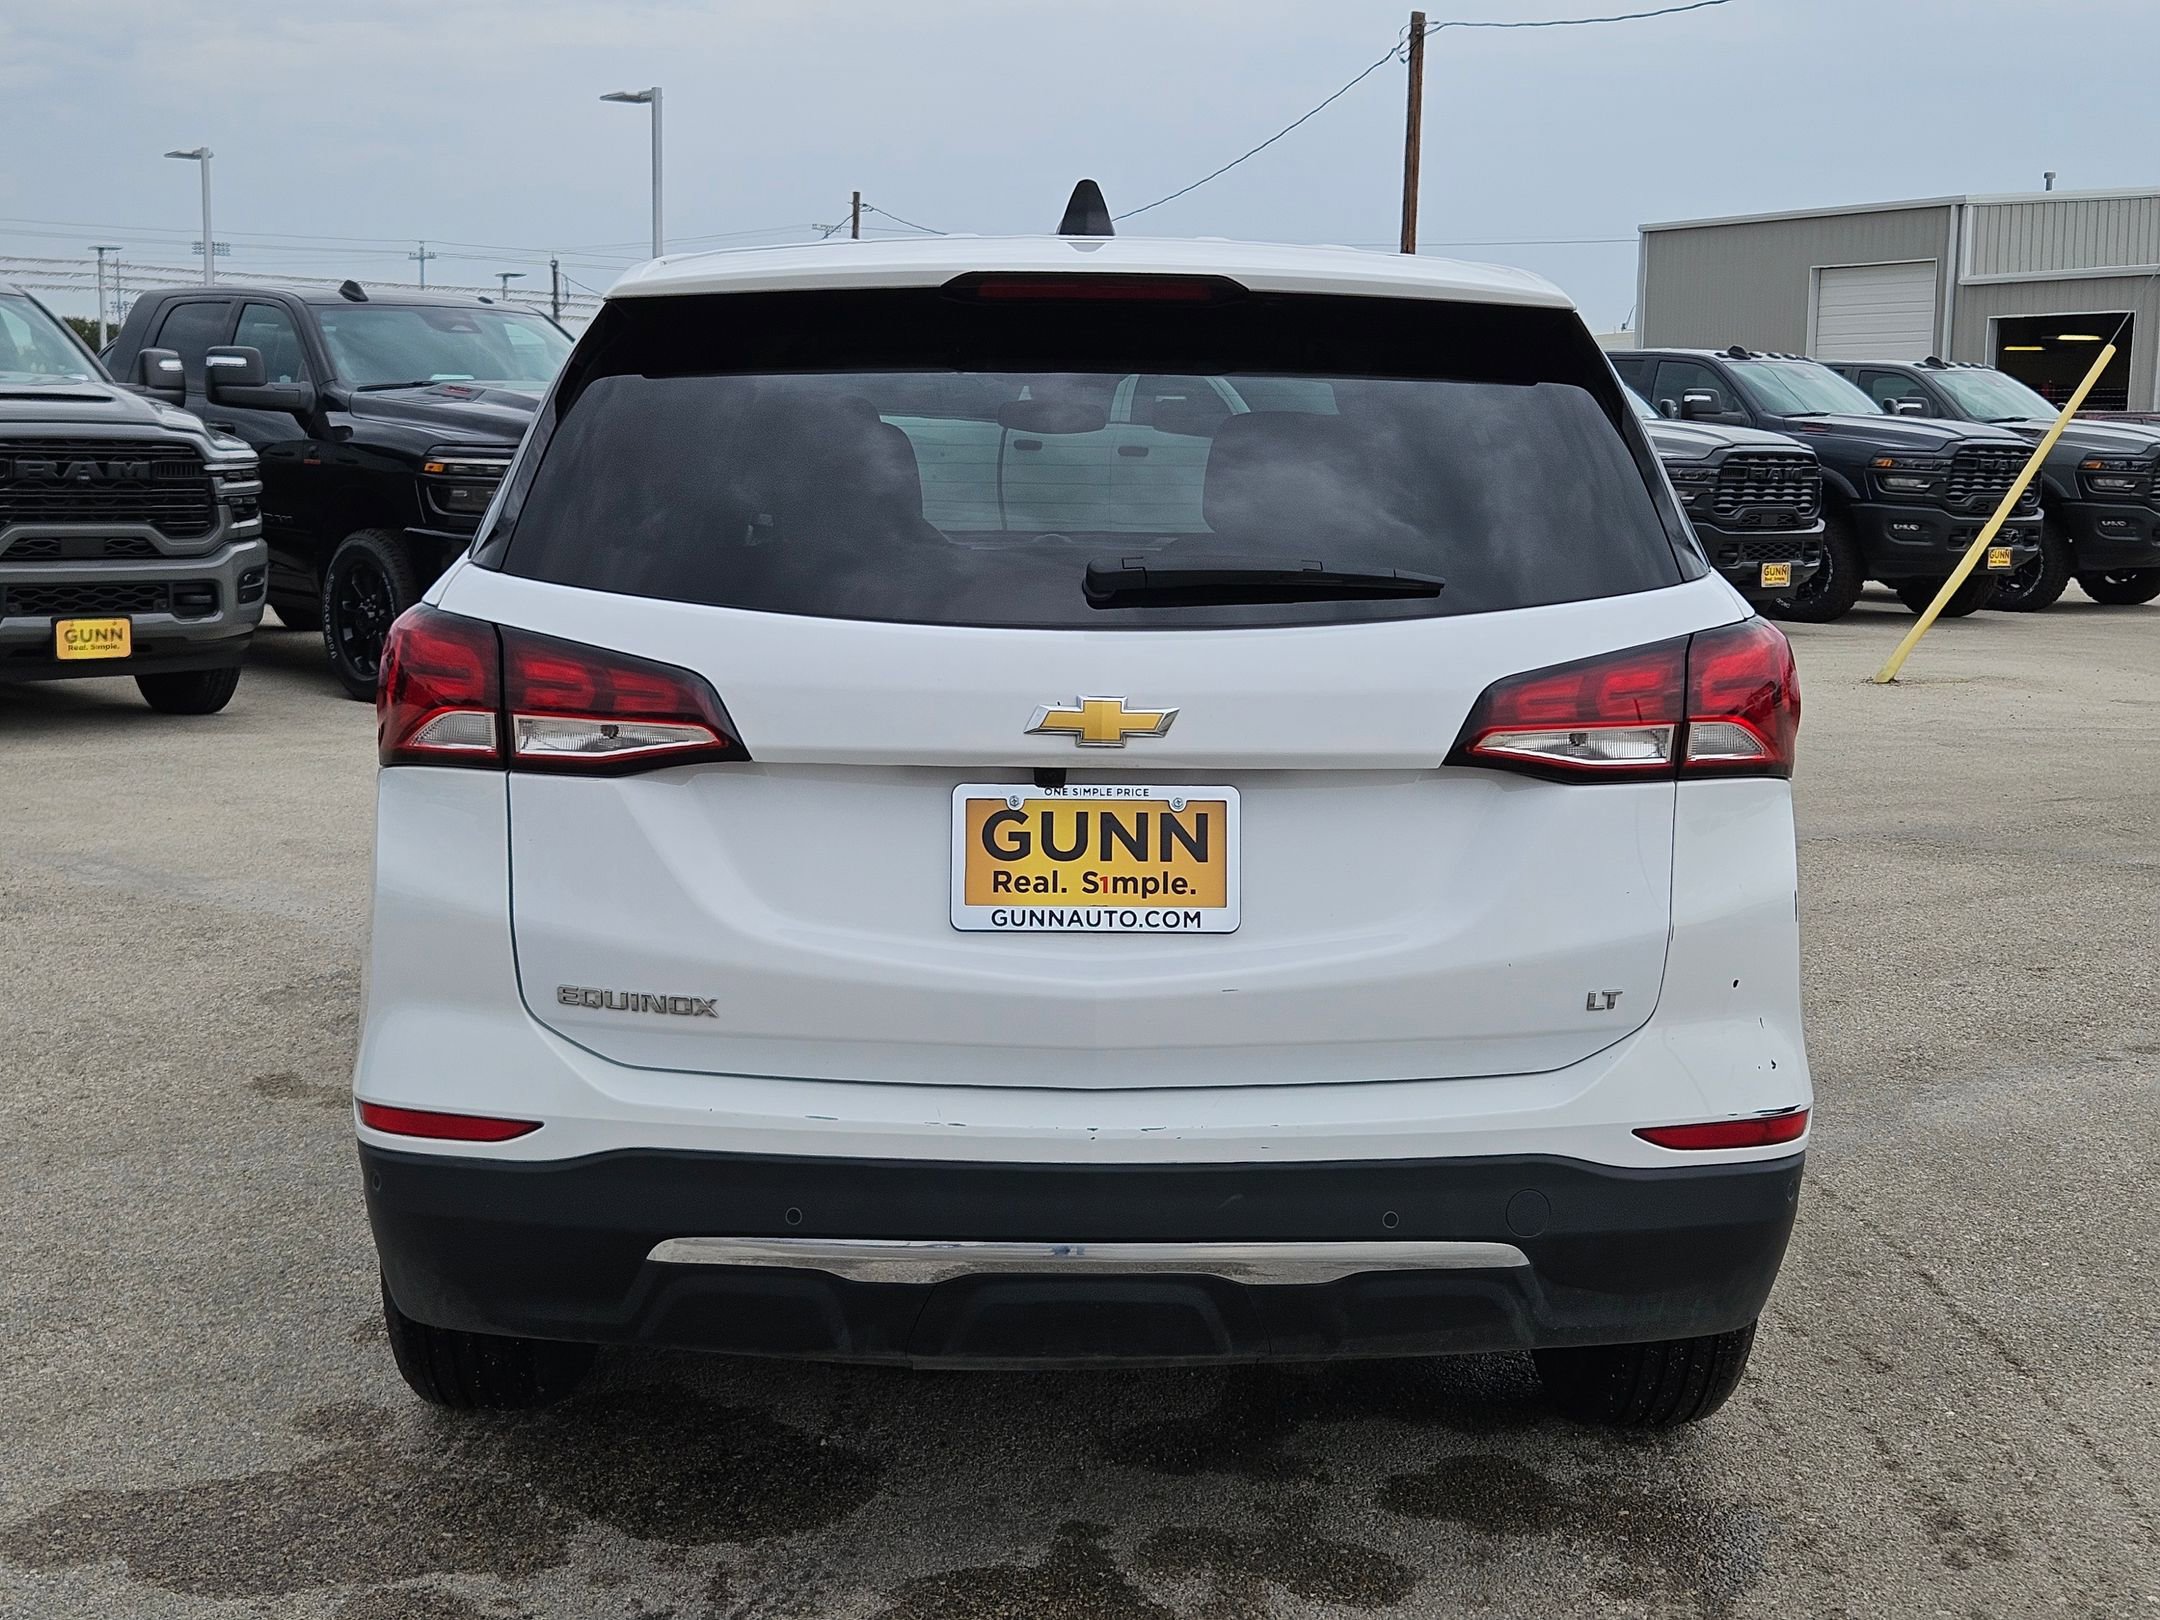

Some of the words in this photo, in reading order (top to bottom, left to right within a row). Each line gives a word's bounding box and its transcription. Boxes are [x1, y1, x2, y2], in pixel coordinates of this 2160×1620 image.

[15, 460, 150, 480] RAM
[1990, 550, 2010, 559] GUNN
[1764, 567, 1787, 576] GUNN
[64, 627, 123, 644] GUNN
[1044, 787, 1068, 796] ONE
[1072, 787, 1113, 797] SIMPLE
[1116, 788, 1149, 797] PRICE
[981, 809, 1209, 863] GUNN
[992, 870, 1067, 894] Real.
[991, 909, 1201, 929] GUNNAUTO.COM
[557, 984, 719, 1018] EQUINOX
[1586, 989, 1624, 1011] LT
